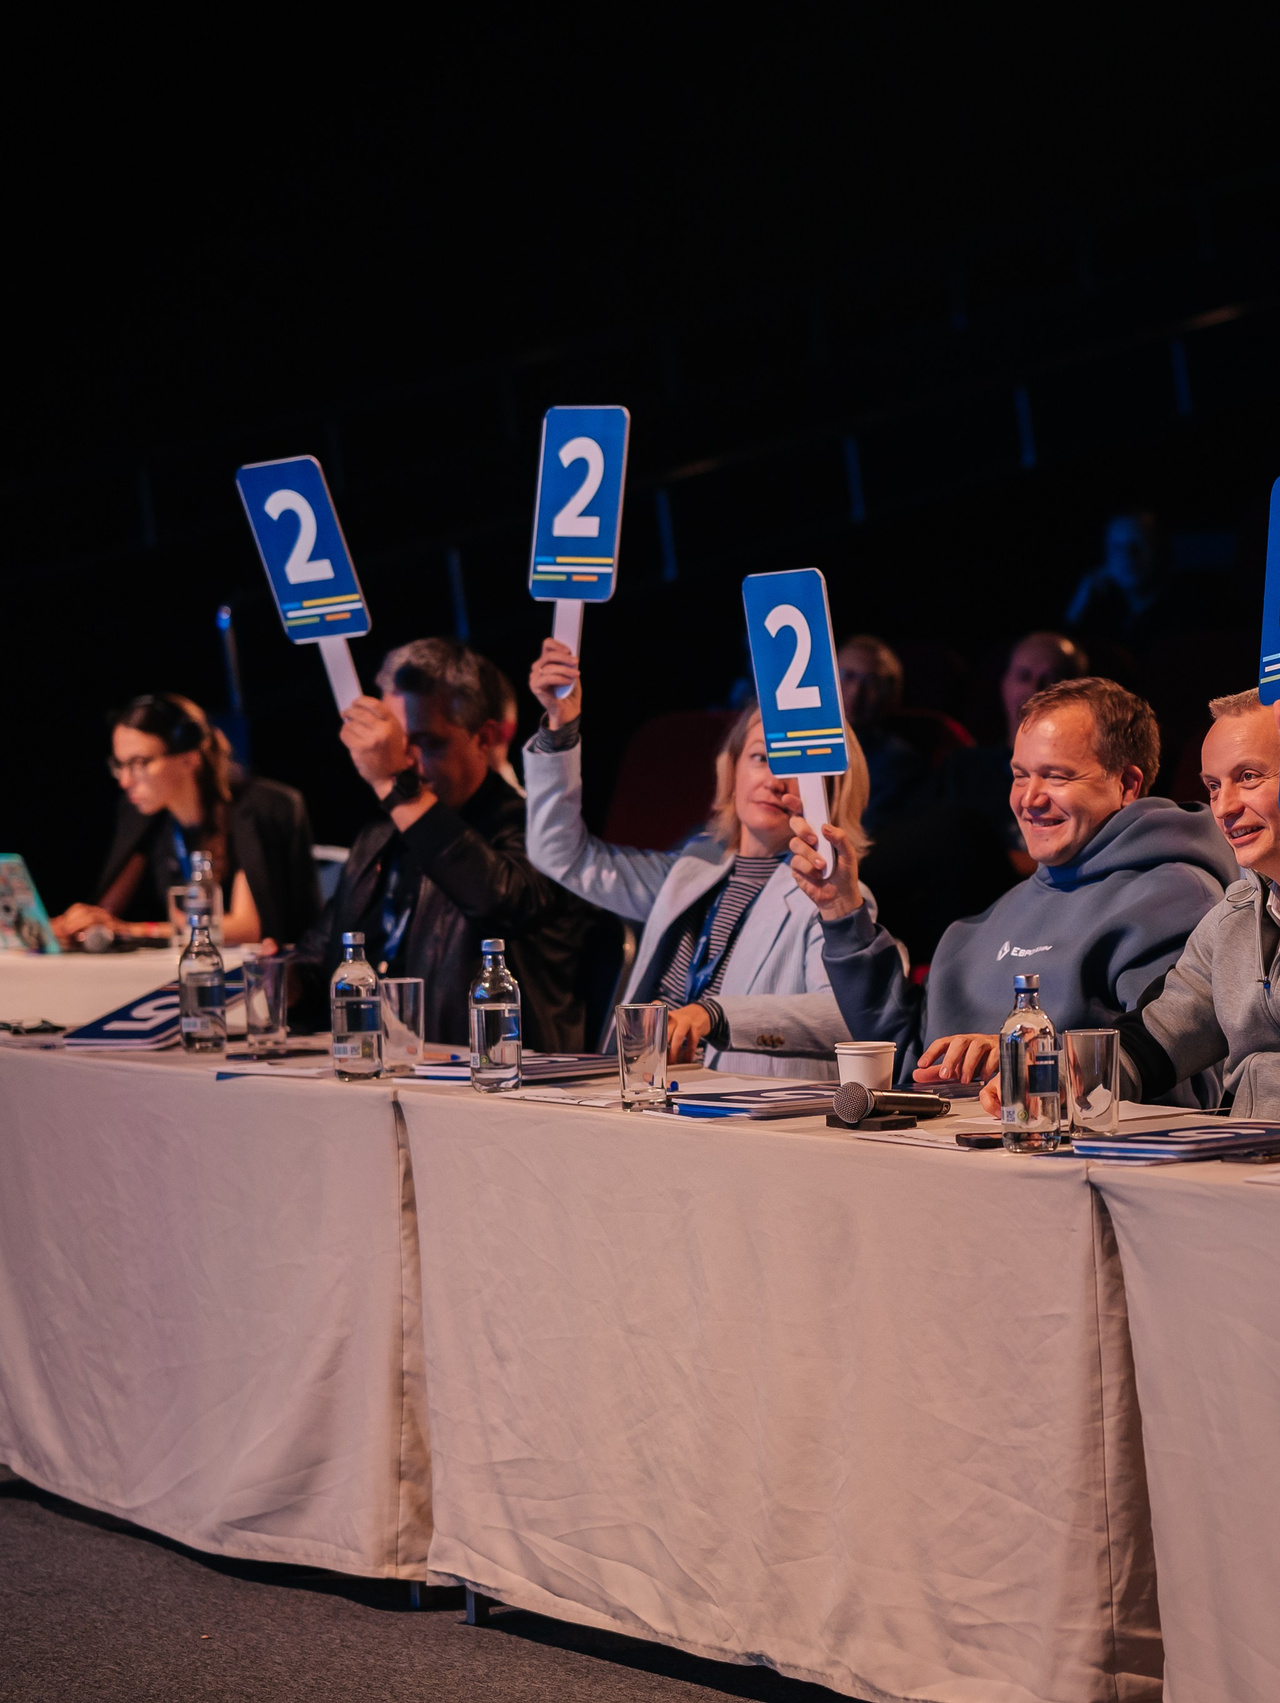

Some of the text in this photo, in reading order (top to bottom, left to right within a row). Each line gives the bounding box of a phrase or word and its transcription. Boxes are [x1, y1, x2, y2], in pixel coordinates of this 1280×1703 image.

[263, 488, 335, 585] 2
[552, 436, 605, 538] 2
[763, 603, 823, 712] 2
